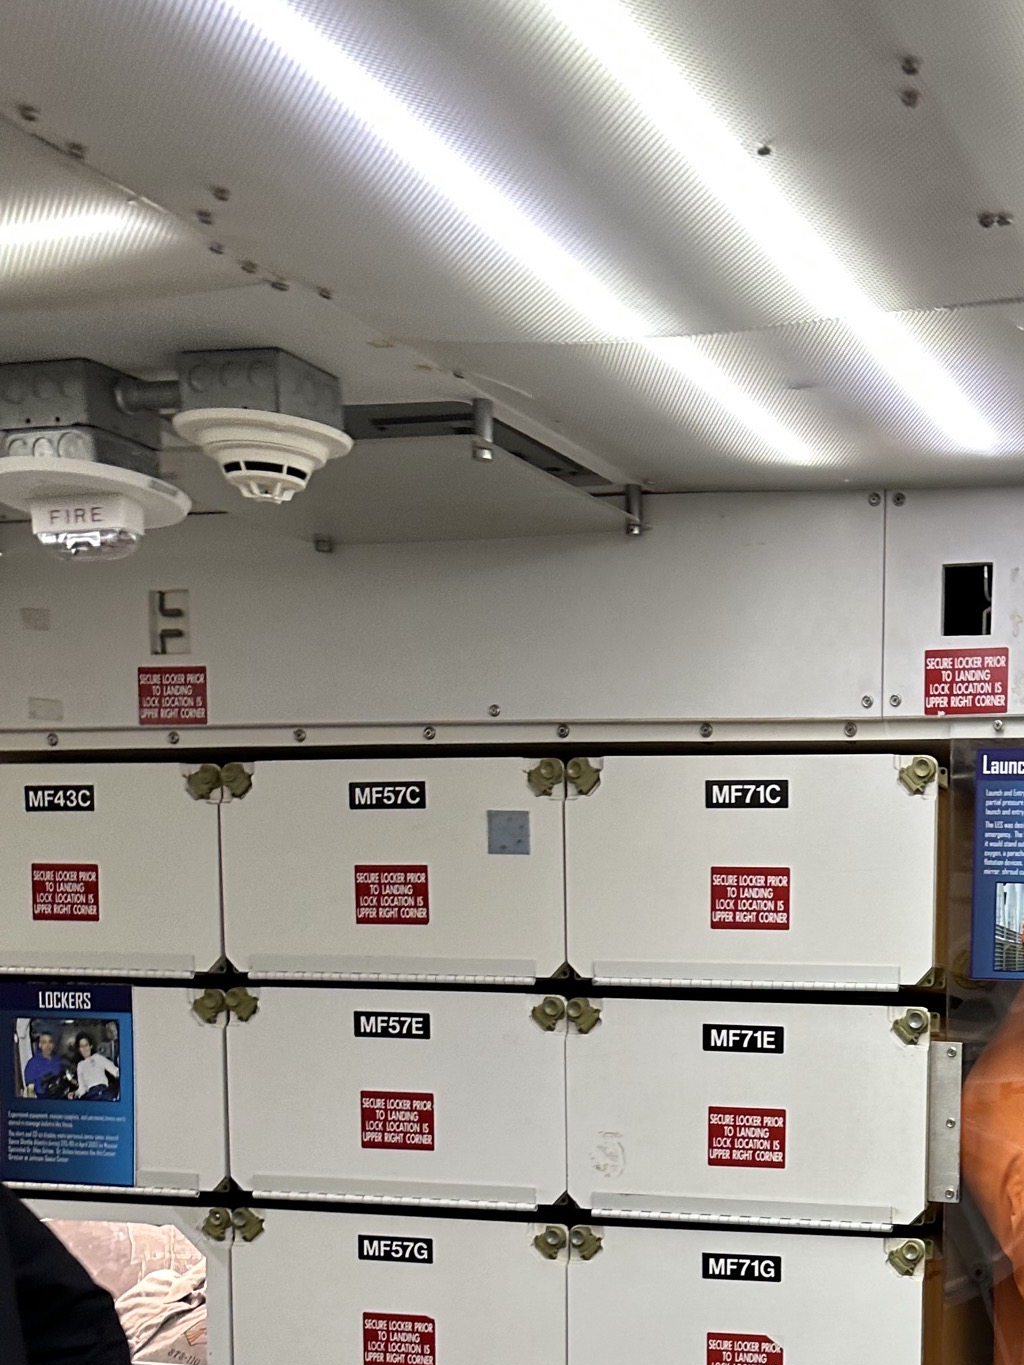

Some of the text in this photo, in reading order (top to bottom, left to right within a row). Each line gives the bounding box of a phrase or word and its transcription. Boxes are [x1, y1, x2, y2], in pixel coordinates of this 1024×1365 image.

[50, 506, 103, 525] FIRE
[926, 655, 1006, 669] SECURE LOCKER PRIOR
[941, 669, 990, 681] TO LANDING
[929, 681, 1002, 694] LOCK LOCATION IS
[926, 694, 1005, 707] UPPER RIGHT CORNER
[28, 789, 91, 807] MF43C
[354, 785, 420, 805] MF57C
[712, 784, 781, 804] MF71C
[33, 870, 96, 881] SECURE LOCKER PRIOR
[356, 872, 425, 883] SECURE LOCKER PRIOR
[712, 874, 787, 886] SECURE LOCKER PRIOR
[45, 882, 84, 892] TO LANDING
[369, 884, 412, 894] TO LANDING
[726, 887, 773, 898] TO LANDING
[36, 893, 94, 903] LOCK LOCATION IS
[359, 896, 423, 906] LOCK LOCATION IS
[715, 899, 784, 910] LOCK LOCATION IS
[34, 904, 97, 914] UPPER RIGHT CORNER
[357, 907, 427, 917] UPPER RIGHT CORNER
[712, 911, 787, 923] UPPER RIGHT CORNER
[38, 990, 91, 1010] LOCKERS
[360, 1015, 424, 1035] MF57E
[710, 1028, 776, 1049] MF71E
[362, 1097, 431, 1110] SECURE LOCKER PRIOR
[375, 1109, 418, 1121] TO LANDING
[709, 1113, 783, 1127] SECURE LOCKER PRIOR
[365, 1120, 429, 1132] LOCK LOCATION IS
[723, 1126, 769, 1138] TO LANDING
[362, 1131, 432, 1144] UPPER RIGHT CORNER
[712, 1137, 779, 1150] LOCK LOCATION IS
[709, 1148, 783, 1161] UPPER RIGHT CORNER
[363, 1239, 428, 1260] MF57G
[708, 1257, 775, 1278] MF71G
[364, 1319, 433, 1332] SECURE LOCKER PRIOR
[377, 1330, 420, 1342] TO LANDING
[367, 1341, 430, 1354] LOCK LOCATION IS
[708, 1339, 732, 1350] SECURE
[734, 1340, 759, 1351] LOCKER
[365, 1351, 433, 1365] UPPER RIGHT CORNER
[722, 1351, 766, 1363] TO LANDING
